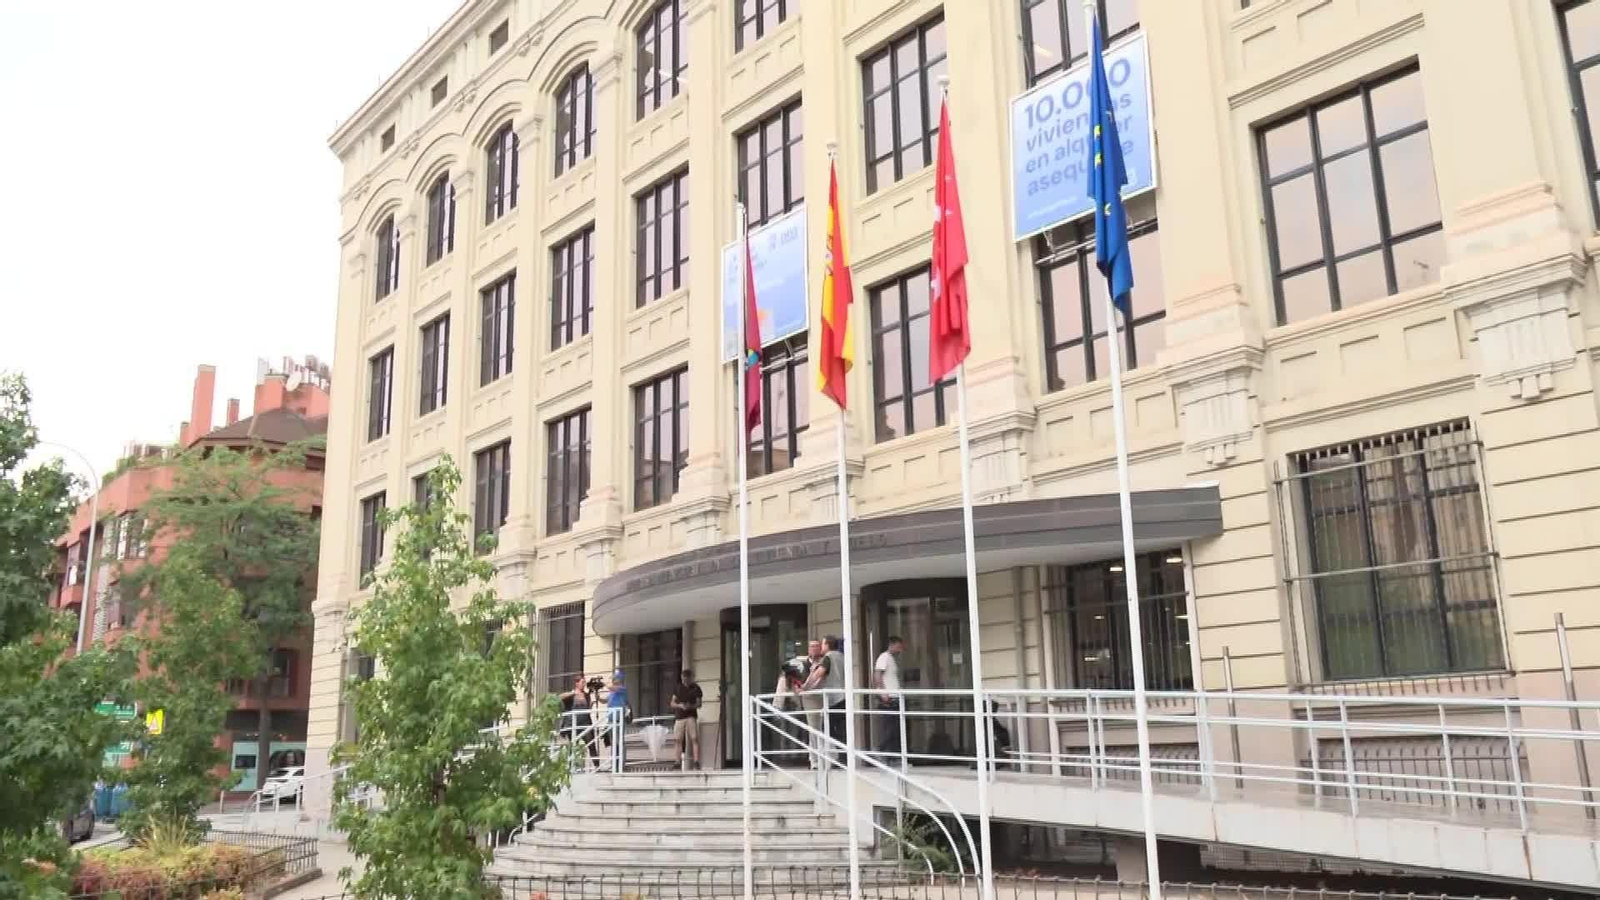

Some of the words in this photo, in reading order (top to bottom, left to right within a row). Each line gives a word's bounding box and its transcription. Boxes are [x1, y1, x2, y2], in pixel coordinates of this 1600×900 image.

[1024, 58, 1131, 129] 10.00
[1026, 93, 1132, 151] viviens
[1025, 154, 1049, 174] en
[1027, 139, 1134, 197] aseque
